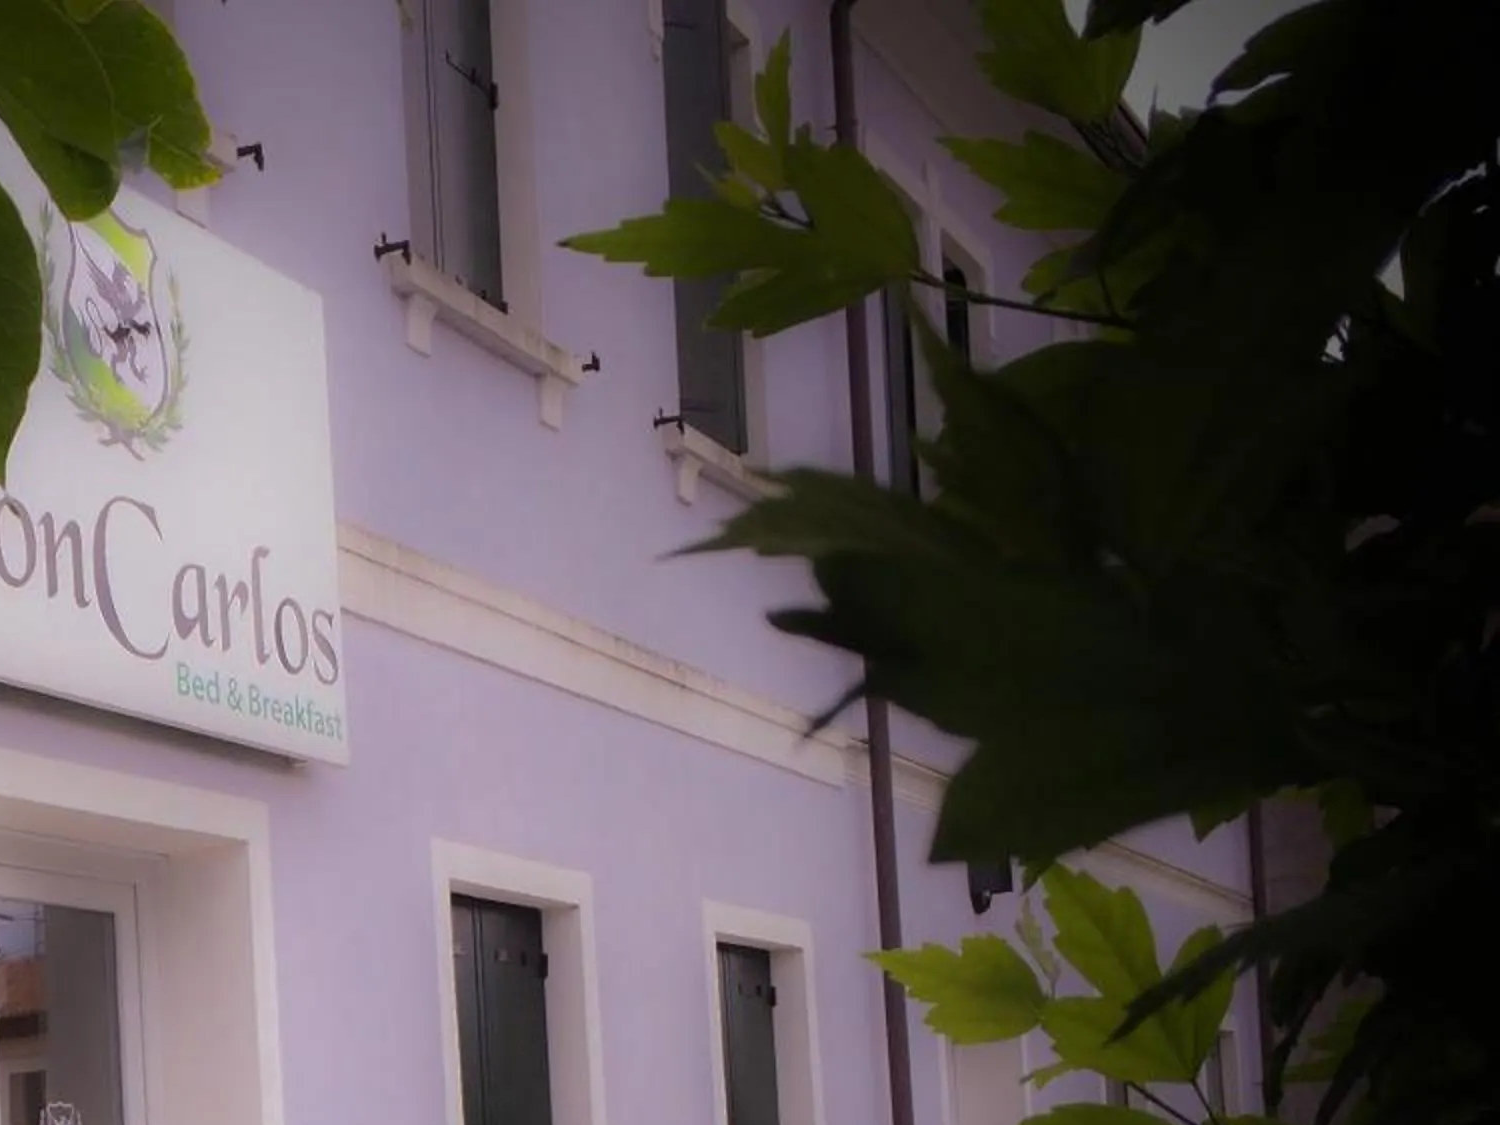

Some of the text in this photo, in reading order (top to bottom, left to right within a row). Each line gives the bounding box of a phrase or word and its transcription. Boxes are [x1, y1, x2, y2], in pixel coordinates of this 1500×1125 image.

[176, 661, 343, 741] Bed & Breakfast
